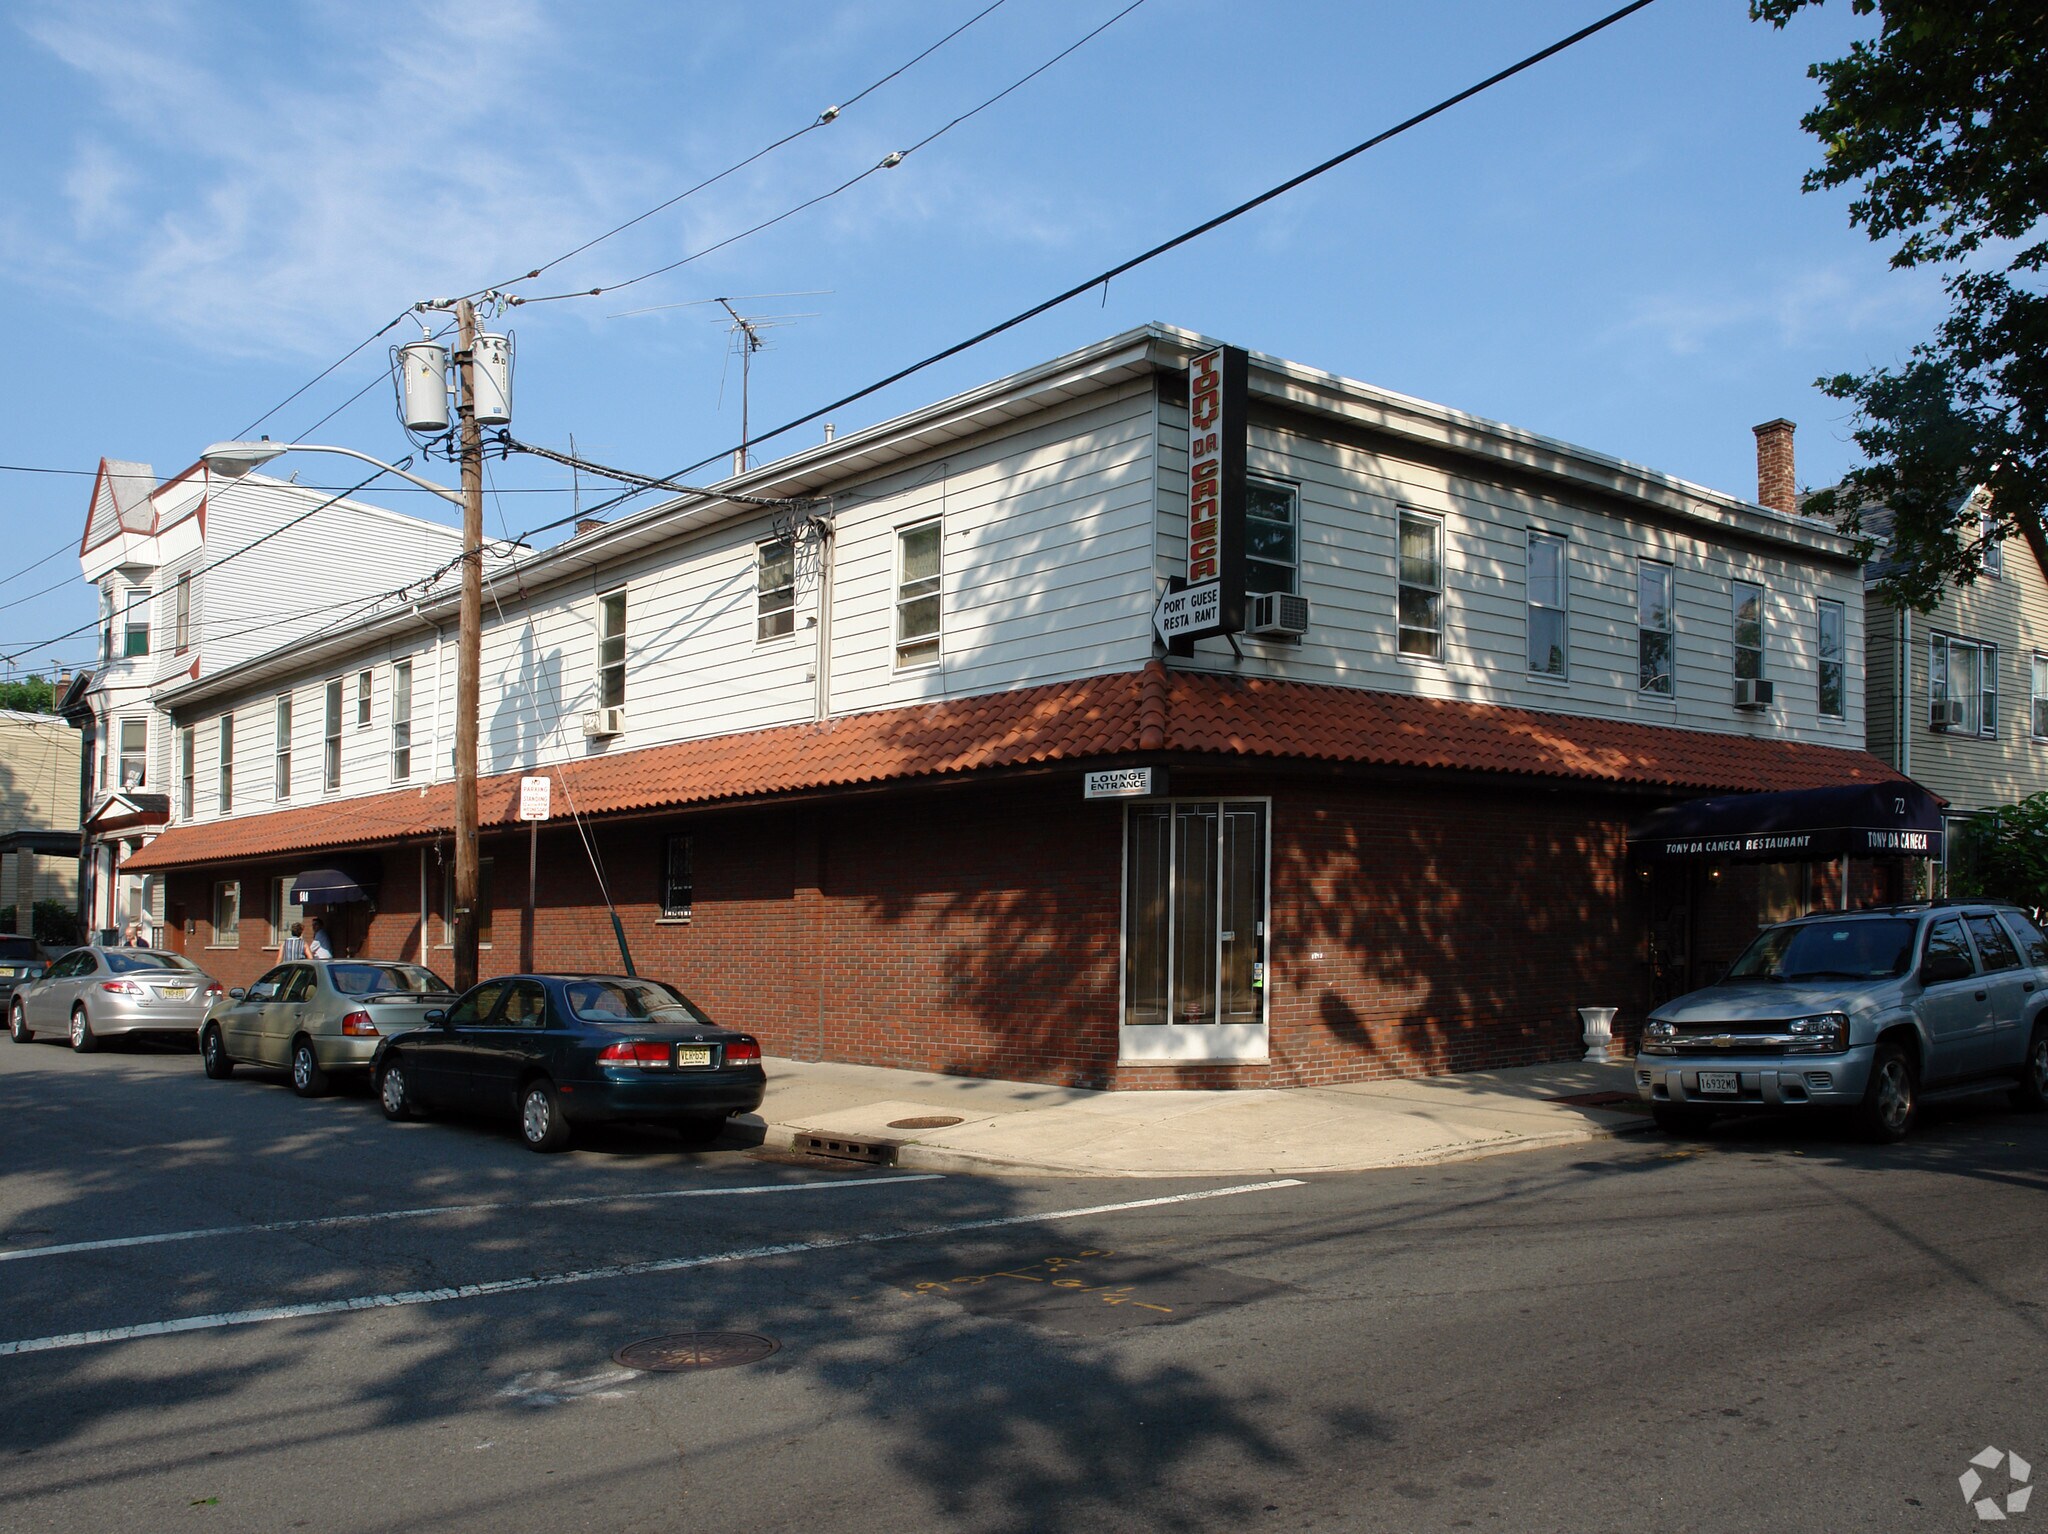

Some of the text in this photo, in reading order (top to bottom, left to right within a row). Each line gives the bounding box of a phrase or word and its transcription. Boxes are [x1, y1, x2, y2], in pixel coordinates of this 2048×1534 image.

[1190, 351, 1220, 582] TONY DA CANECA
[1091, 772, 1146, 783] LOUNGE
[1091, 780, 1147, 791] ENTRANCE
[1894, 797, 1905, 814] 72
[1667, 835, 1811, 854] TONY DA CANECA RESTAURANT
[1867, 831, 1927, 850] TONY DA CANECA
